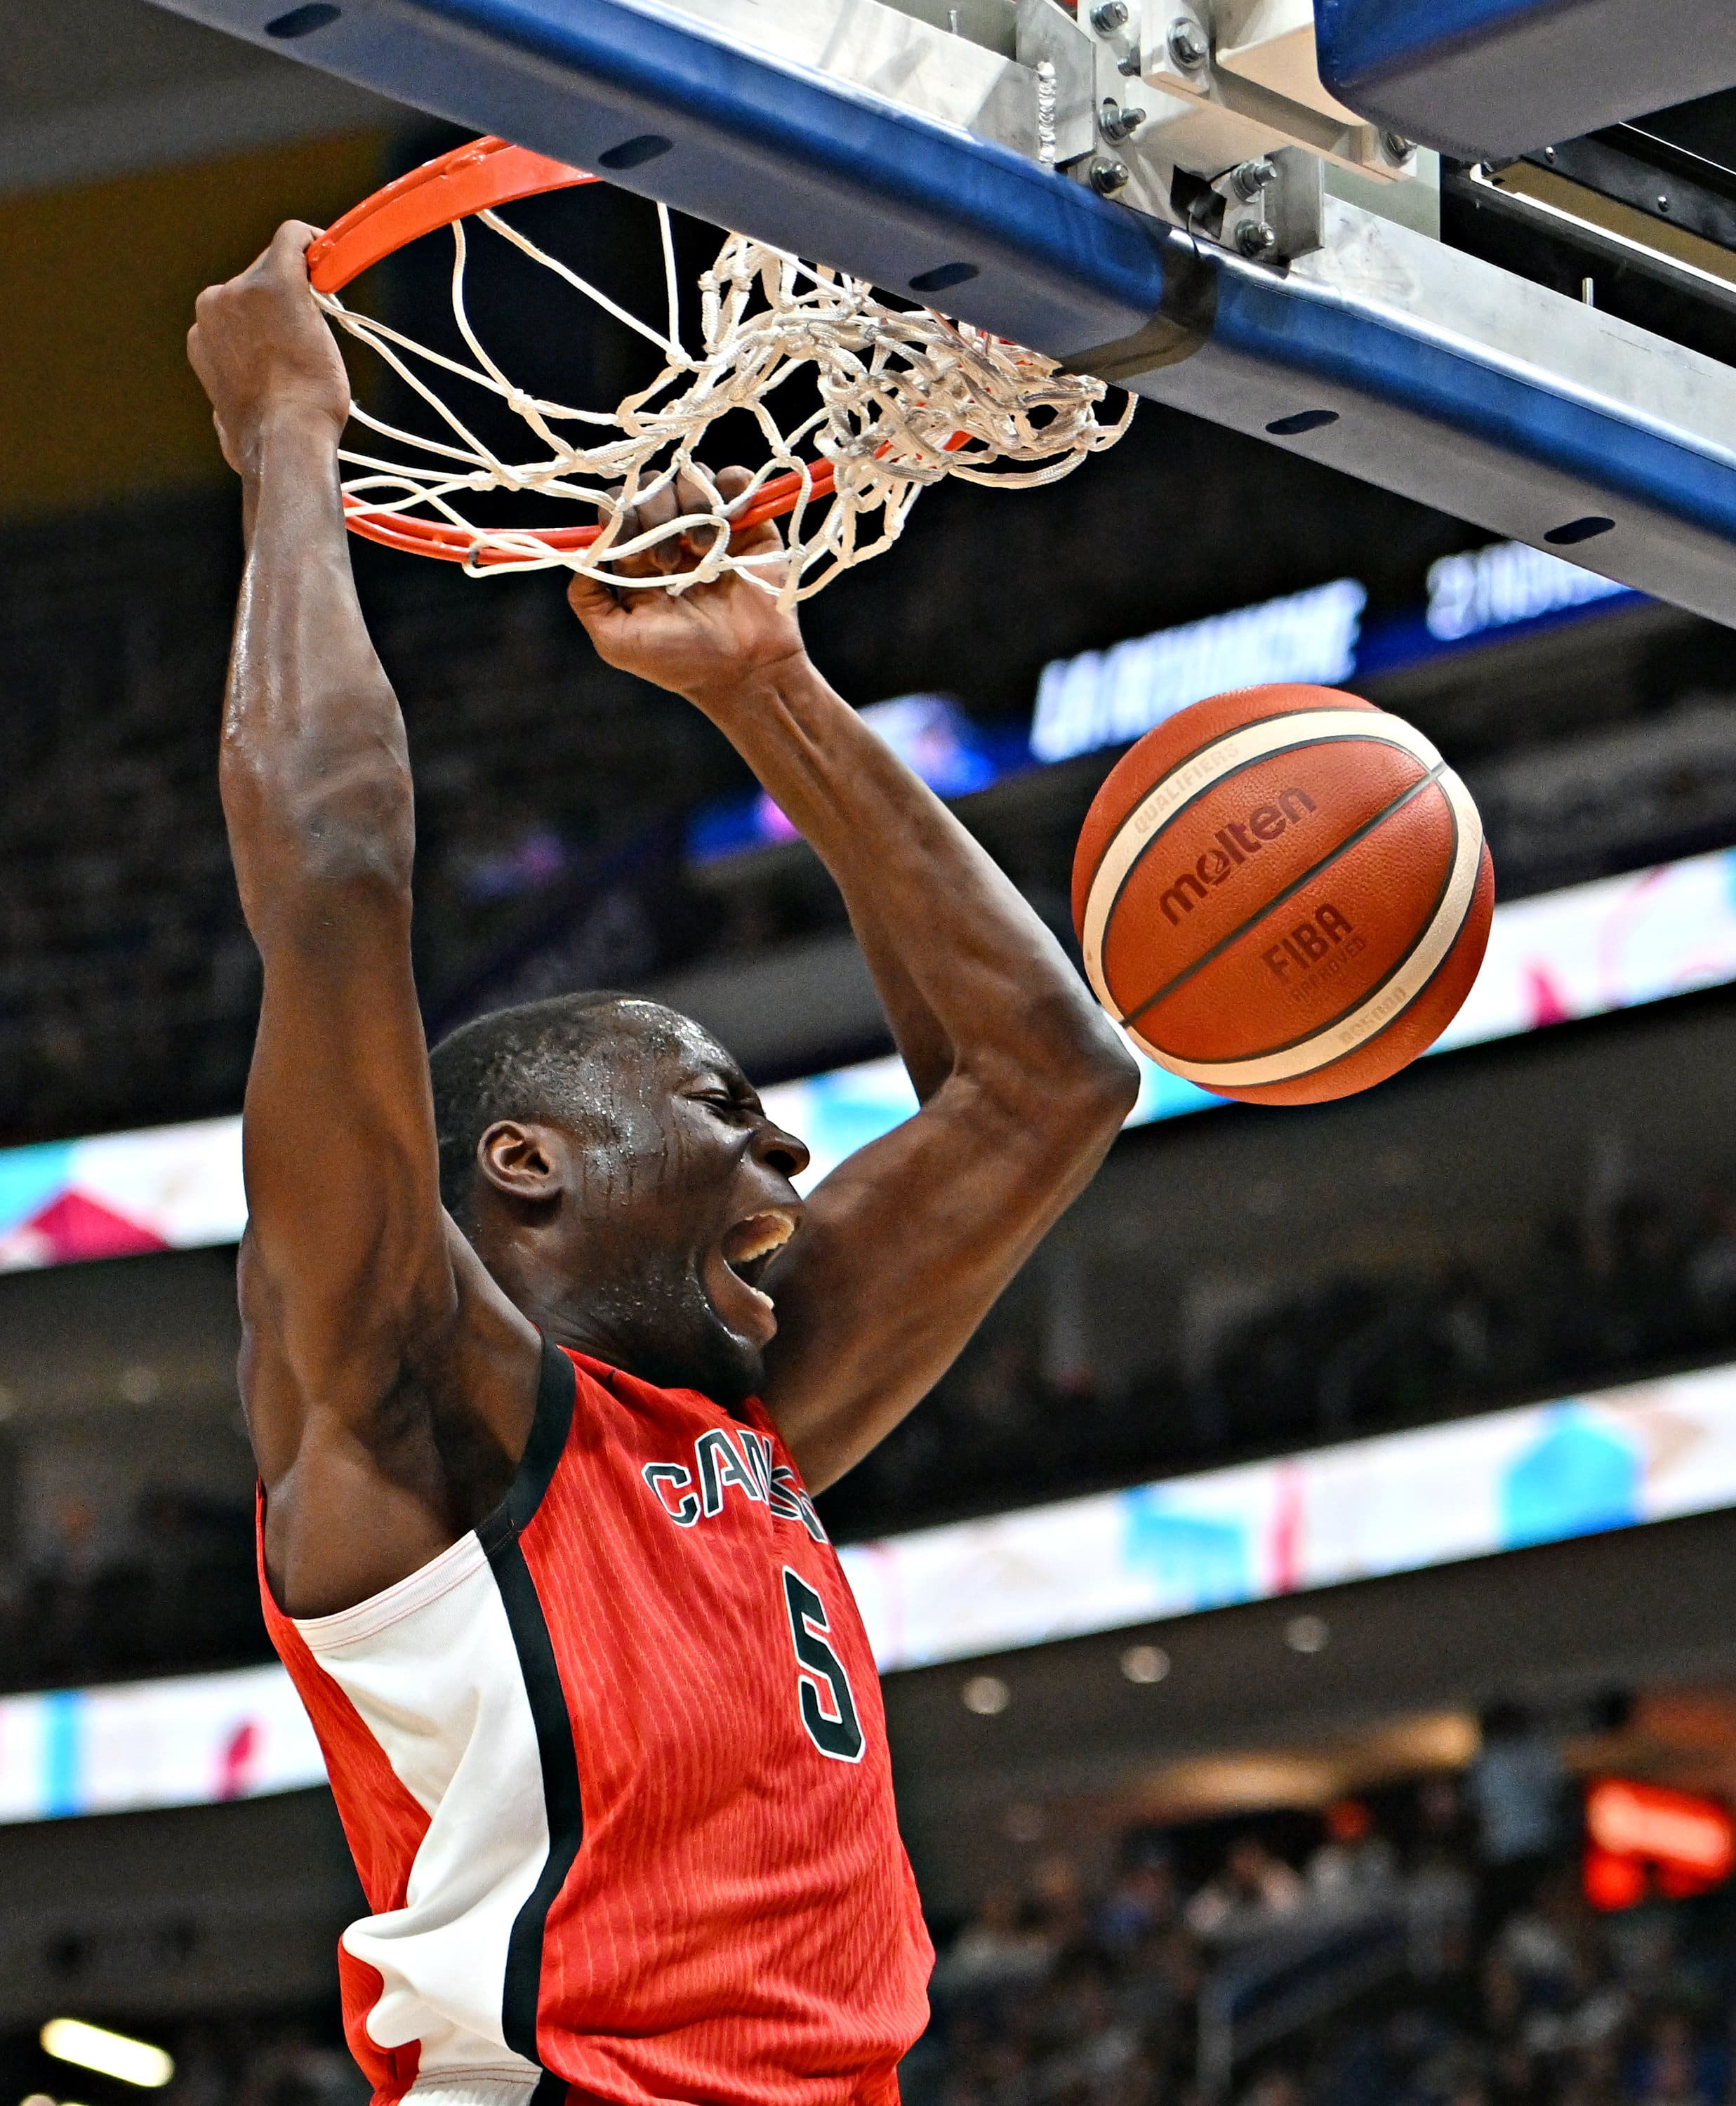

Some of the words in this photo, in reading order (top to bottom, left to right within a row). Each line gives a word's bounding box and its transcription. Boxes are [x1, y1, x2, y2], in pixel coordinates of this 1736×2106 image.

[1134, 743, 1239, 834] QUALIFIERS
[1159, 787, 1317, 926] molten
[1262, 903, 1354, 980] FIBA
[782, 1564, 866, 1764] 5
